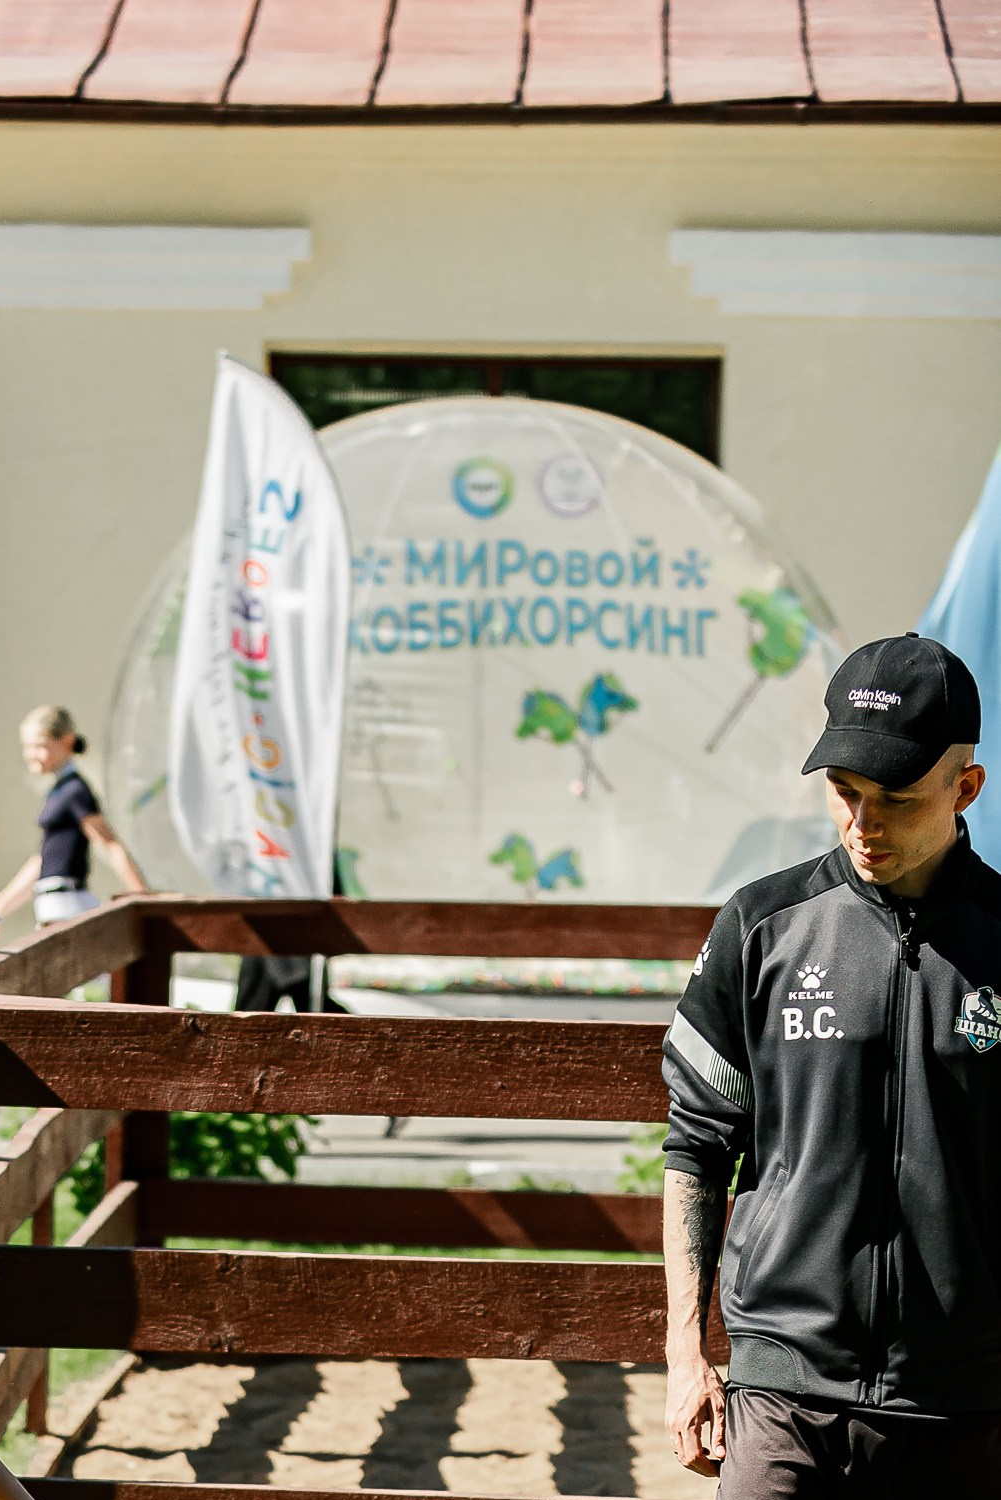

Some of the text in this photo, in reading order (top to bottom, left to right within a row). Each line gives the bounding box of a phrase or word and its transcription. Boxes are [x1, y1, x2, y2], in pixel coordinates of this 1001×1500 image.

[875, 690, 901, 706] Klein
[868, 702, 889, 711] YORK
[788, 991, 835, 1001] KELME
